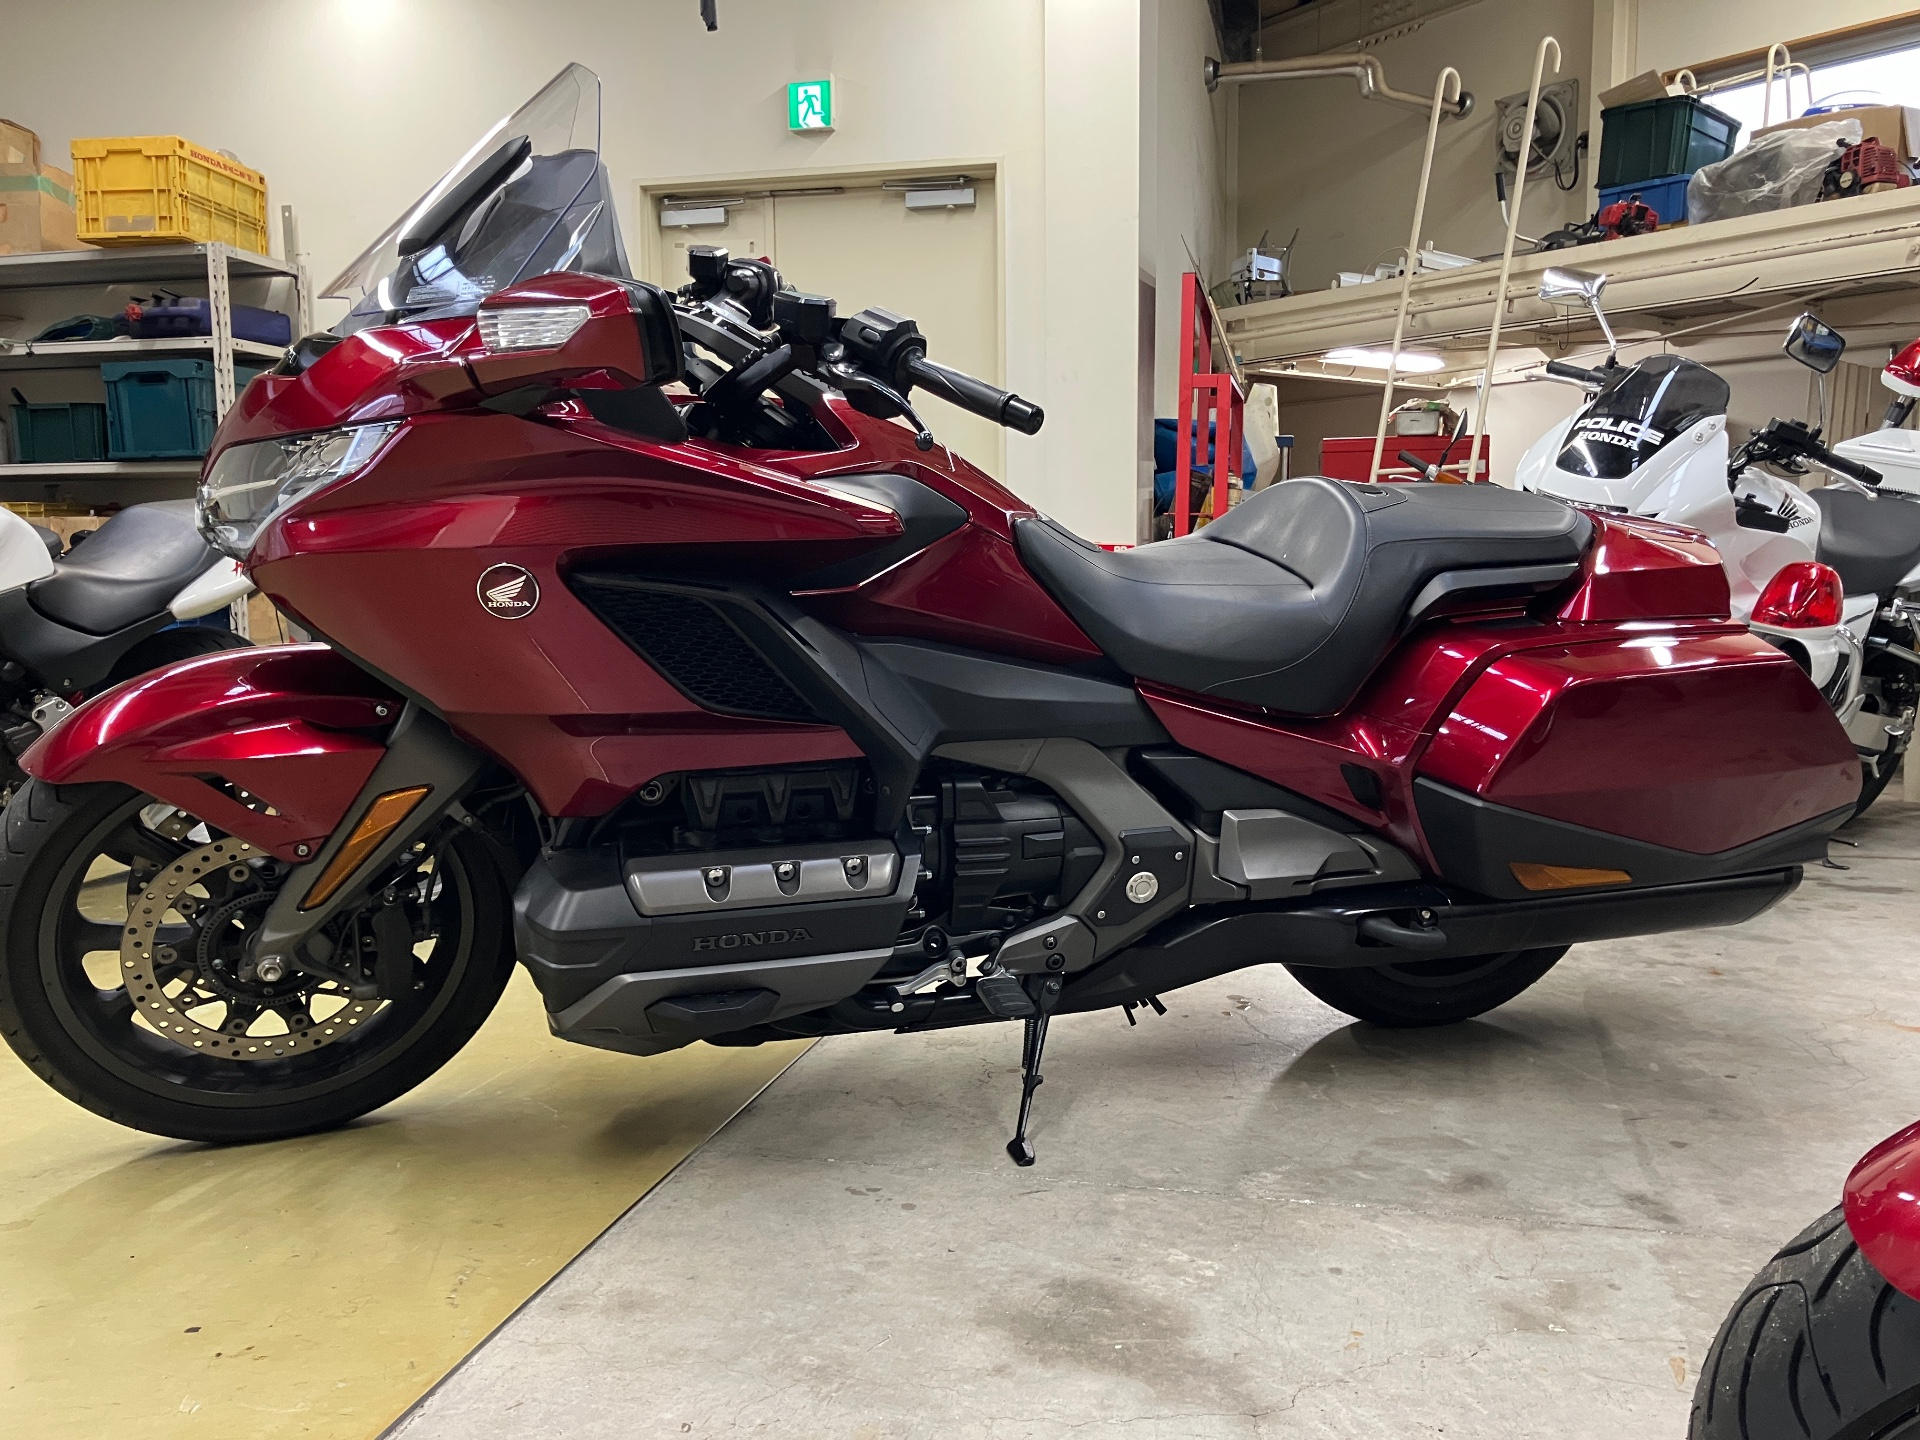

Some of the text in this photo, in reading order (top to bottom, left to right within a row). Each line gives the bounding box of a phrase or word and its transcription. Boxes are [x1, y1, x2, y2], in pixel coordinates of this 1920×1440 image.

[190, 150, 223, 169] HONDA
[1573, 417, 1665, 446] POLICE
[1579, 431, 1639, 451] HONDA
[692, 927, 814, 951] HONDA
